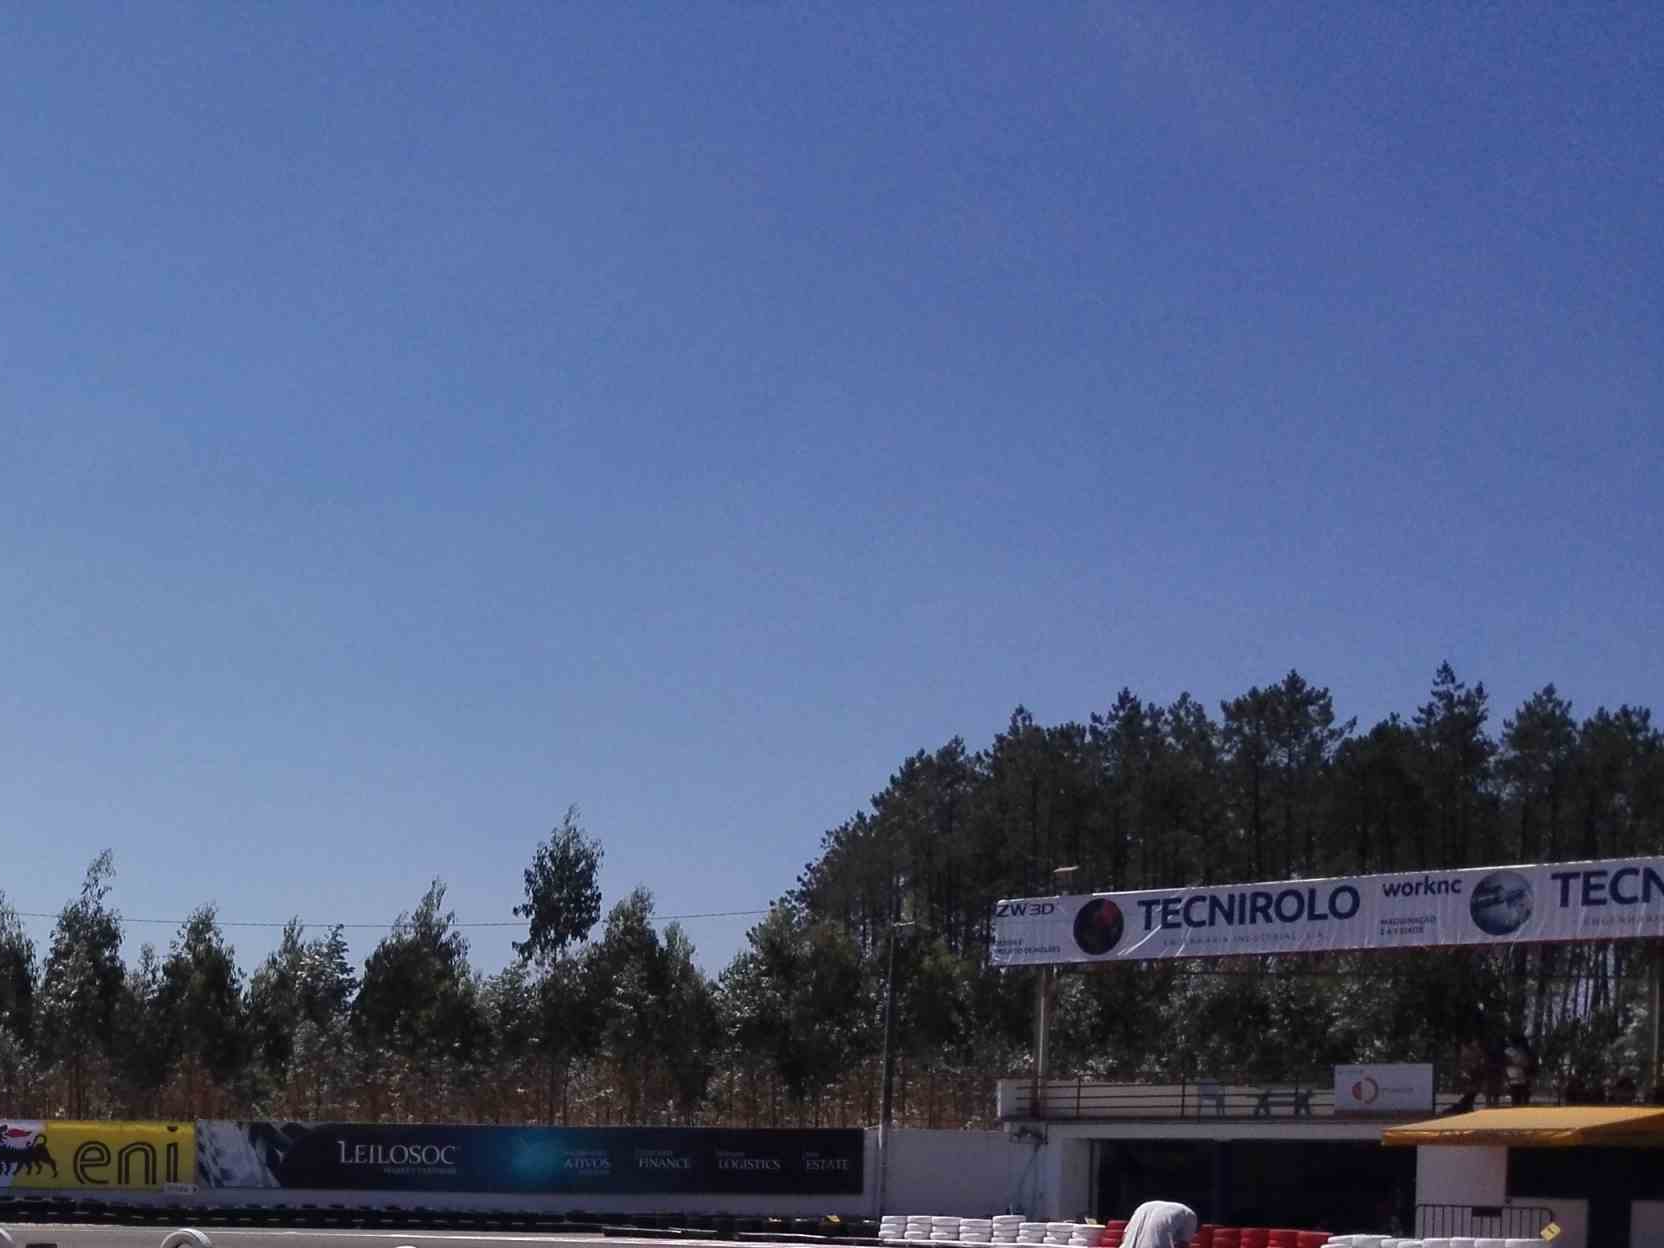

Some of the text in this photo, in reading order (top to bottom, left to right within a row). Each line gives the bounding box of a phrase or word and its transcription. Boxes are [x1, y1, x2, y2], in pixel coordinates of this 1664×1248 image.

[1382, 875, 1463, 898] worknc
[1137, 884, 1361, 931] TECNIROLO
[73, 1125, 180, 1185] eni
[336, 1139, 457, 1165] LEILOSOC
[718, 1158, 782, 1170] LOGISTICS
[805, 1159, 850, 1170] ESTATE
